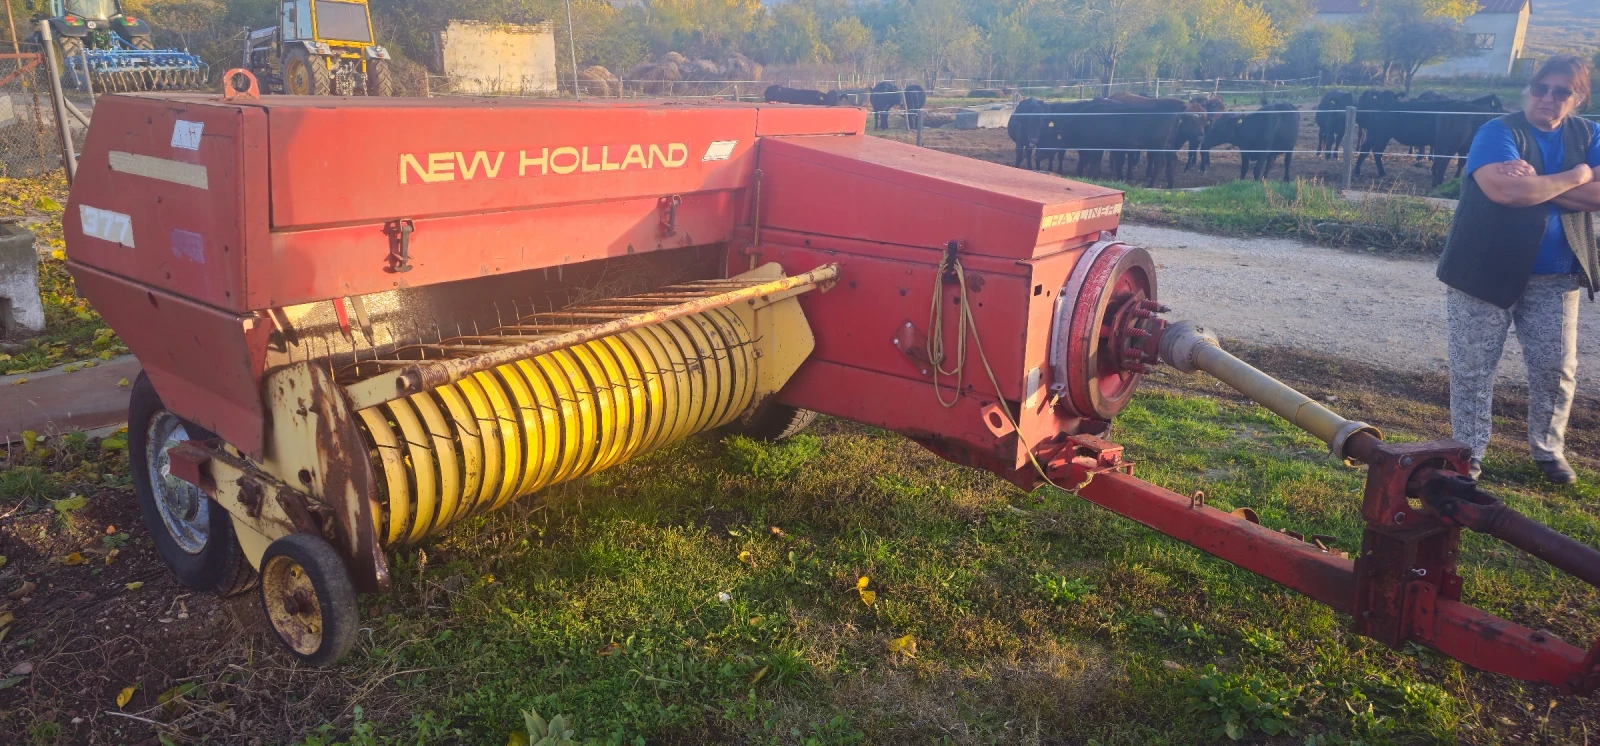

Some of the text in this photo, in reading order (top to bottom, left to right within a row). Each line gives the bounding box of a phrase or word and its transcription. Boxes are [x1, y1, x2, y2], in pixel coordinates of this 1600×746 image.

[400, 151, 504, 184] NEW
[519, 143, 688, 176] HOLLAND
[83, 208, 130, 241] 377
[1050, 204, 1116, 226] HAYLINER
